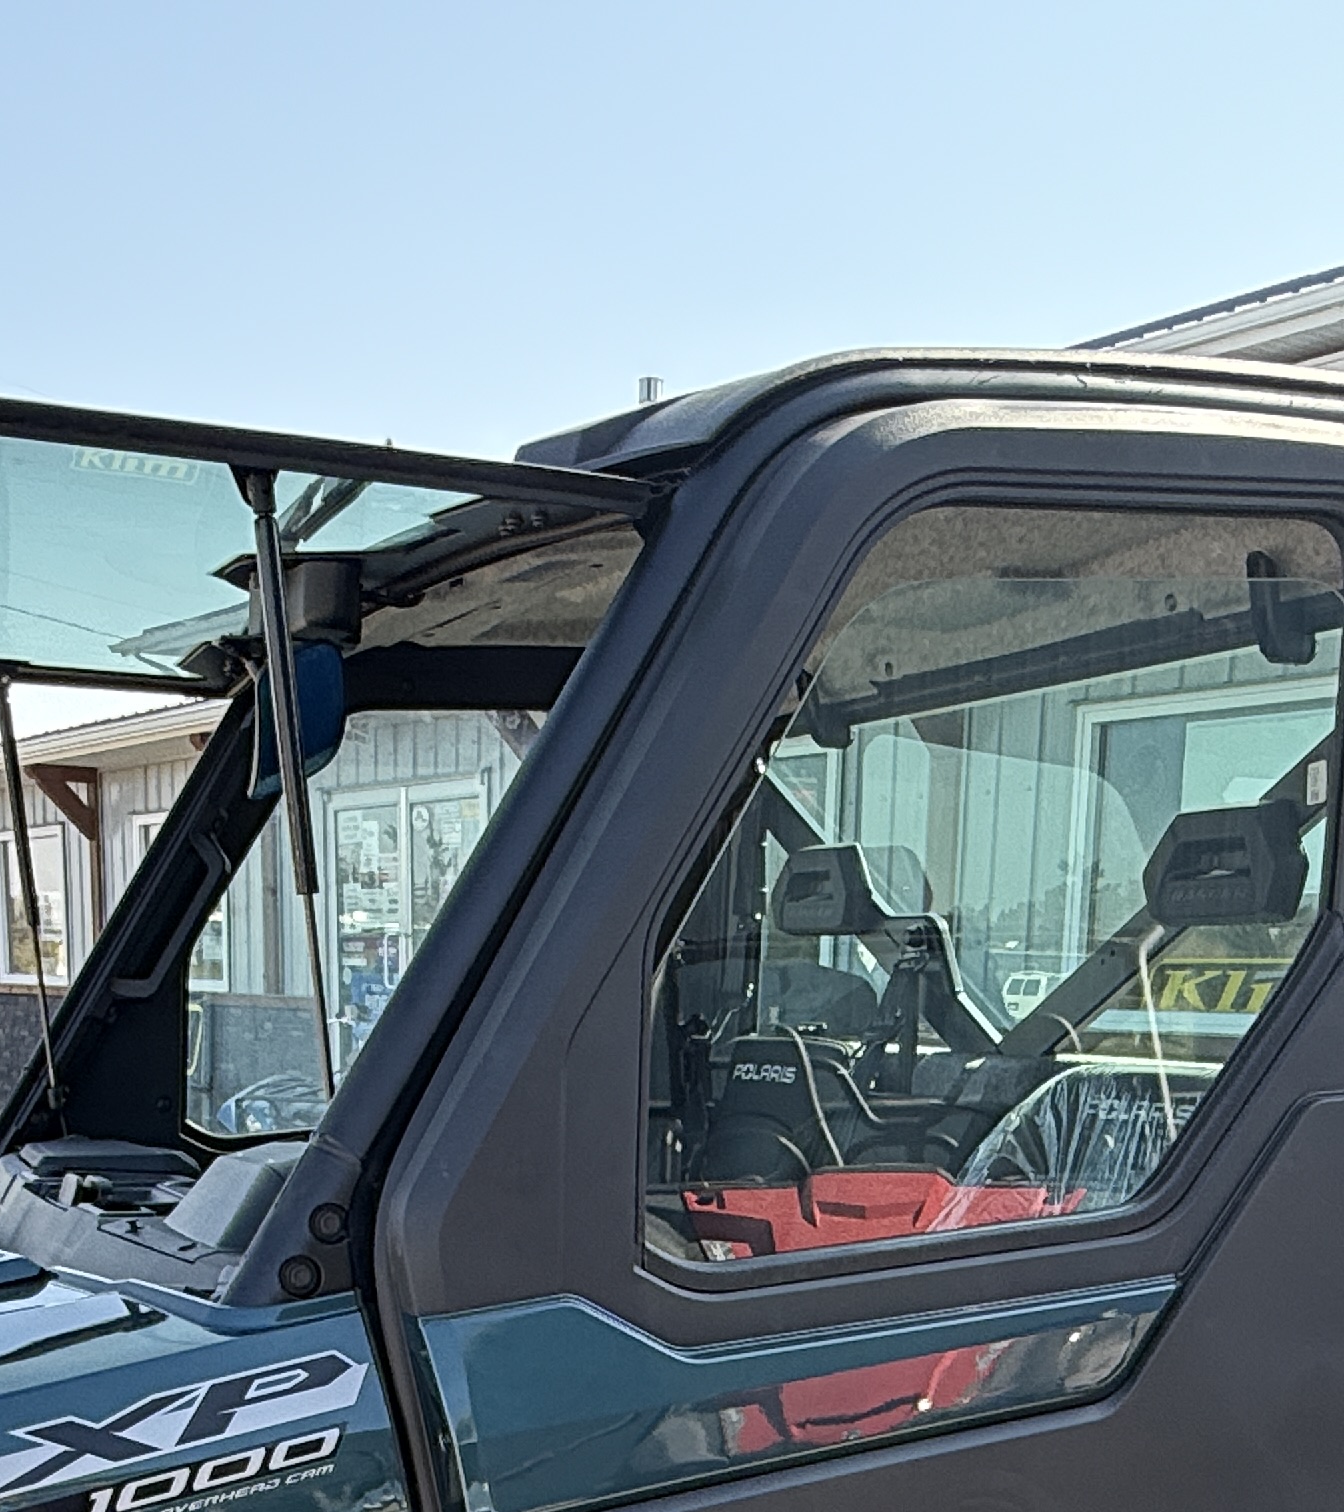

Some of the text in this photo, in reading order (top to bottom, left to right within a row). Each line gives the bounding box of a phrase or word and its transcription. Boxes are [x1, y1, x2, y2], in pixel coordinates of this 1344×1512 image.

[1158, 969, 1274, 1012] Kli
[733, 1063, 797, 1084] POLARIS
[1087, 1099, 1198, 1126] POLARS
[284, 1464, 336, 1486] CAM
